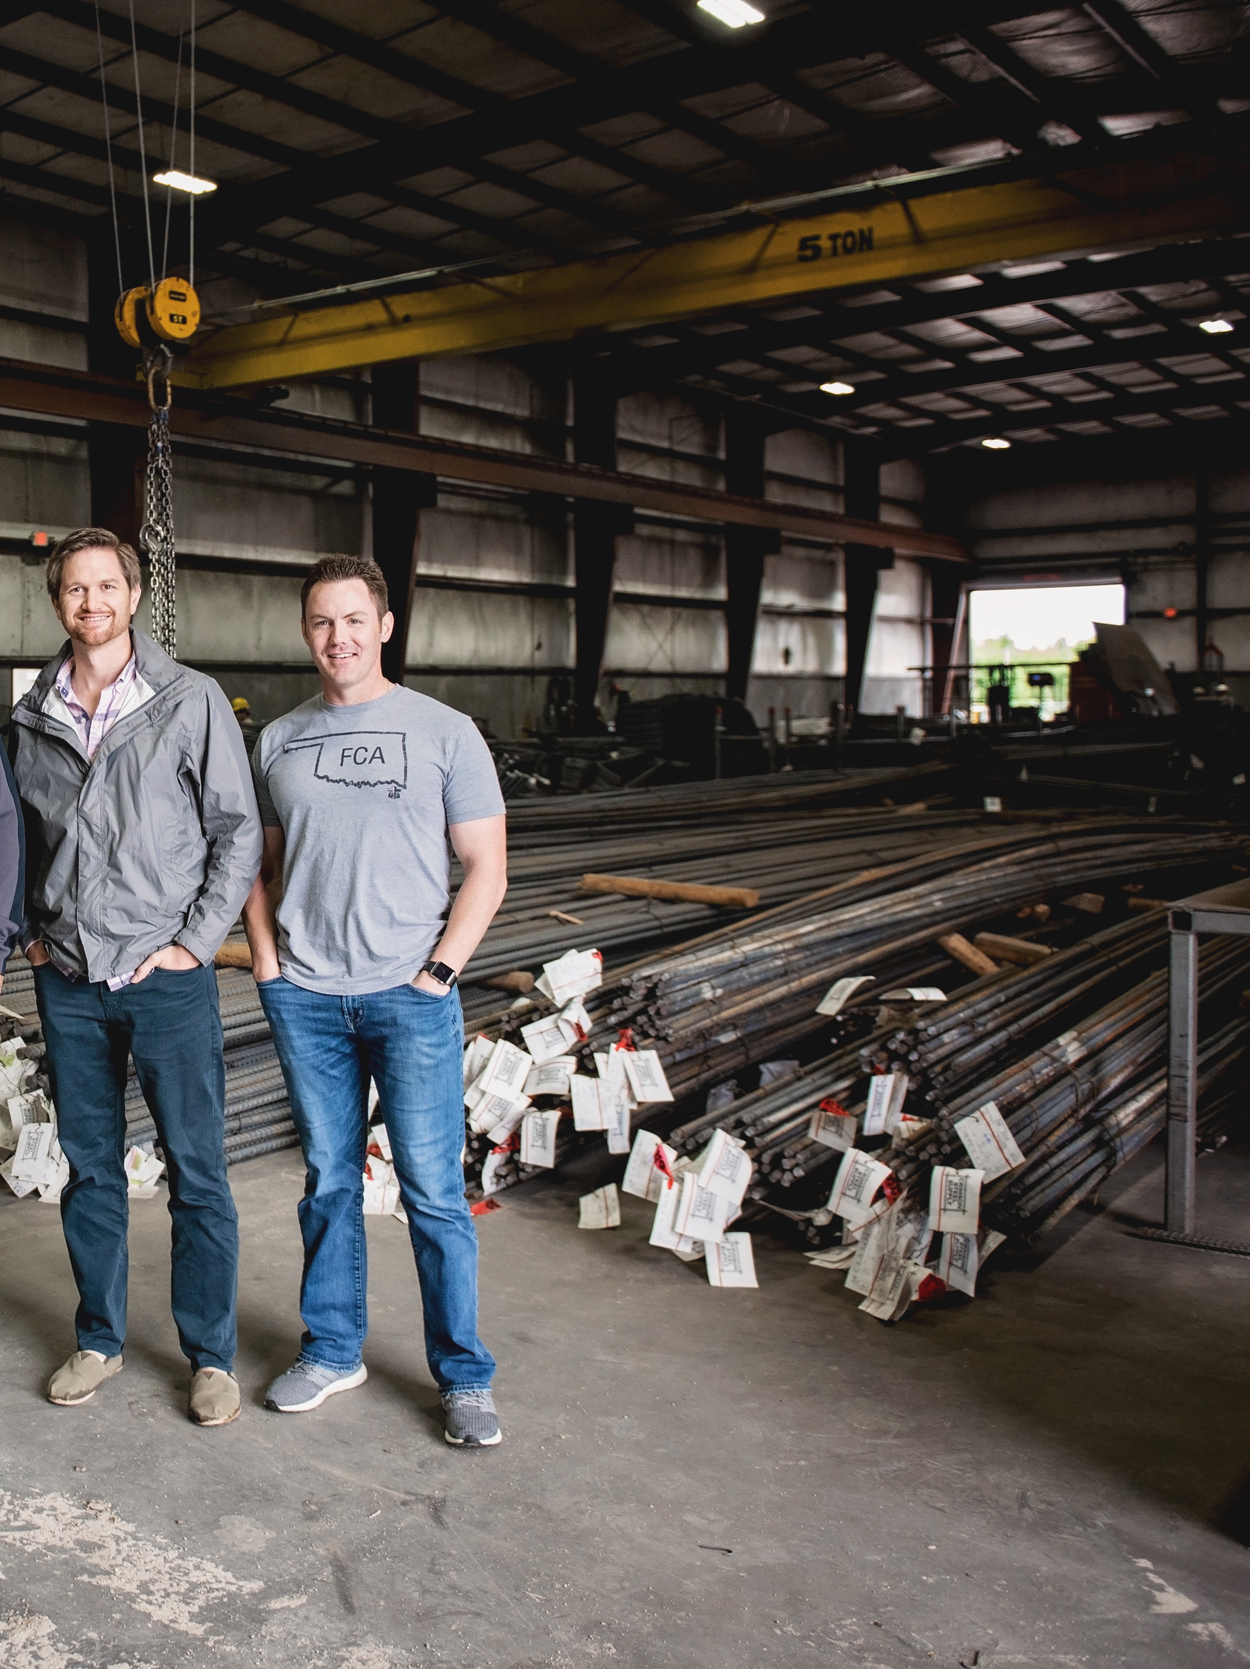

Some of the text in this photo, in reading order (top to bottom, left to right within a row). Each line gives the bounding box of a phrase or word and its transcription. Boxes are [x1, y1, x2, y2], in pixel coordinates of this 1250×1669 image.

[797, 226, 874, 262] 5 TON
[340, 746, 385, 767] FCA
